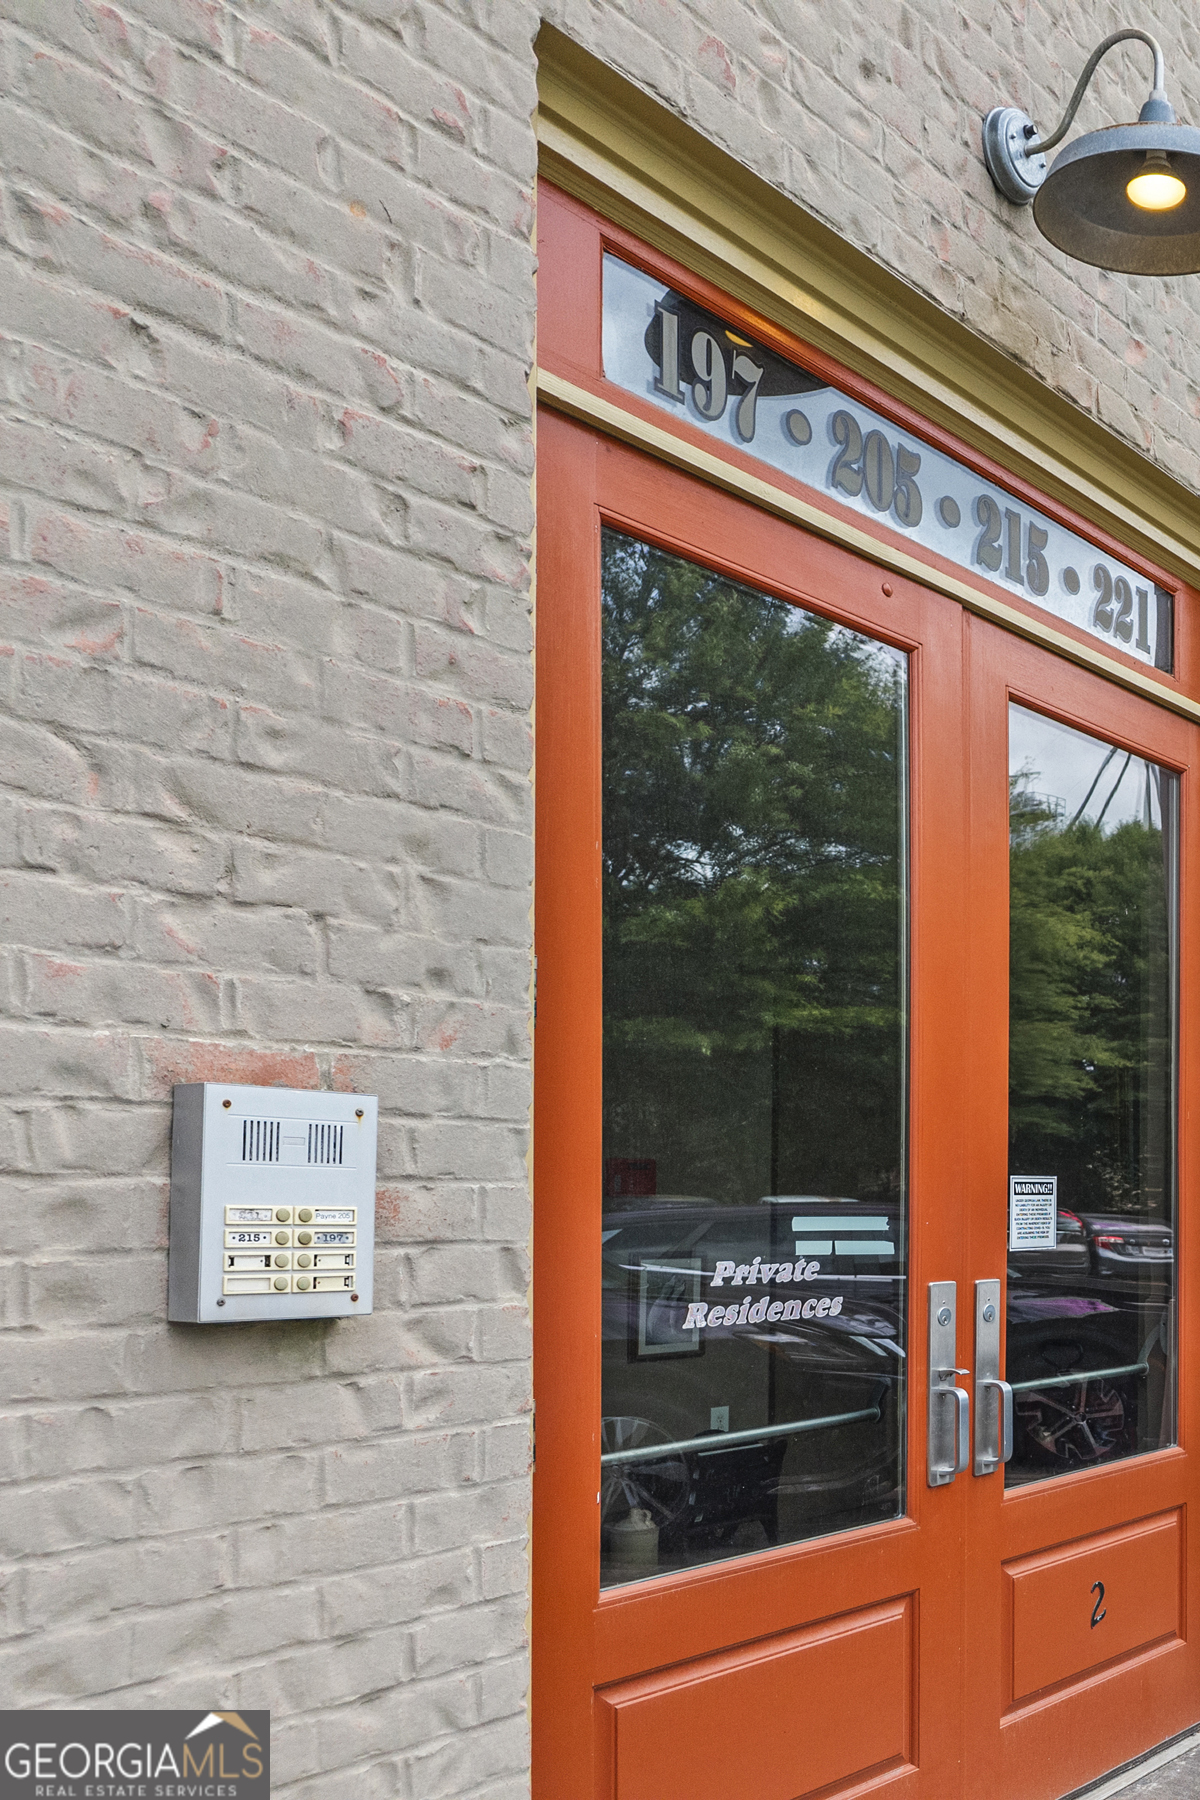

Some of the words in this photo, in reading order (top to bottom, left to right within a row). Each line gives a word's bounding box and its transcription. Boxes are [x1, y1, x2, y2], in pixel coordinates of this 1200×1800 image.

[654, 299, 765, 443] 197
[831, 409, 923, 528] 205
[976, 494, 1050, 597] 215
[1093, 562, 1151, 655] 221
[1014, 1183, 1053, 1194] WARNING!!
[238, 1233, 260, 1242] 215
[323, 1233, 343, 1242] 197
[709, 1256, 821, 1287] Private
[682, 1295, 844, 1330] Residences
